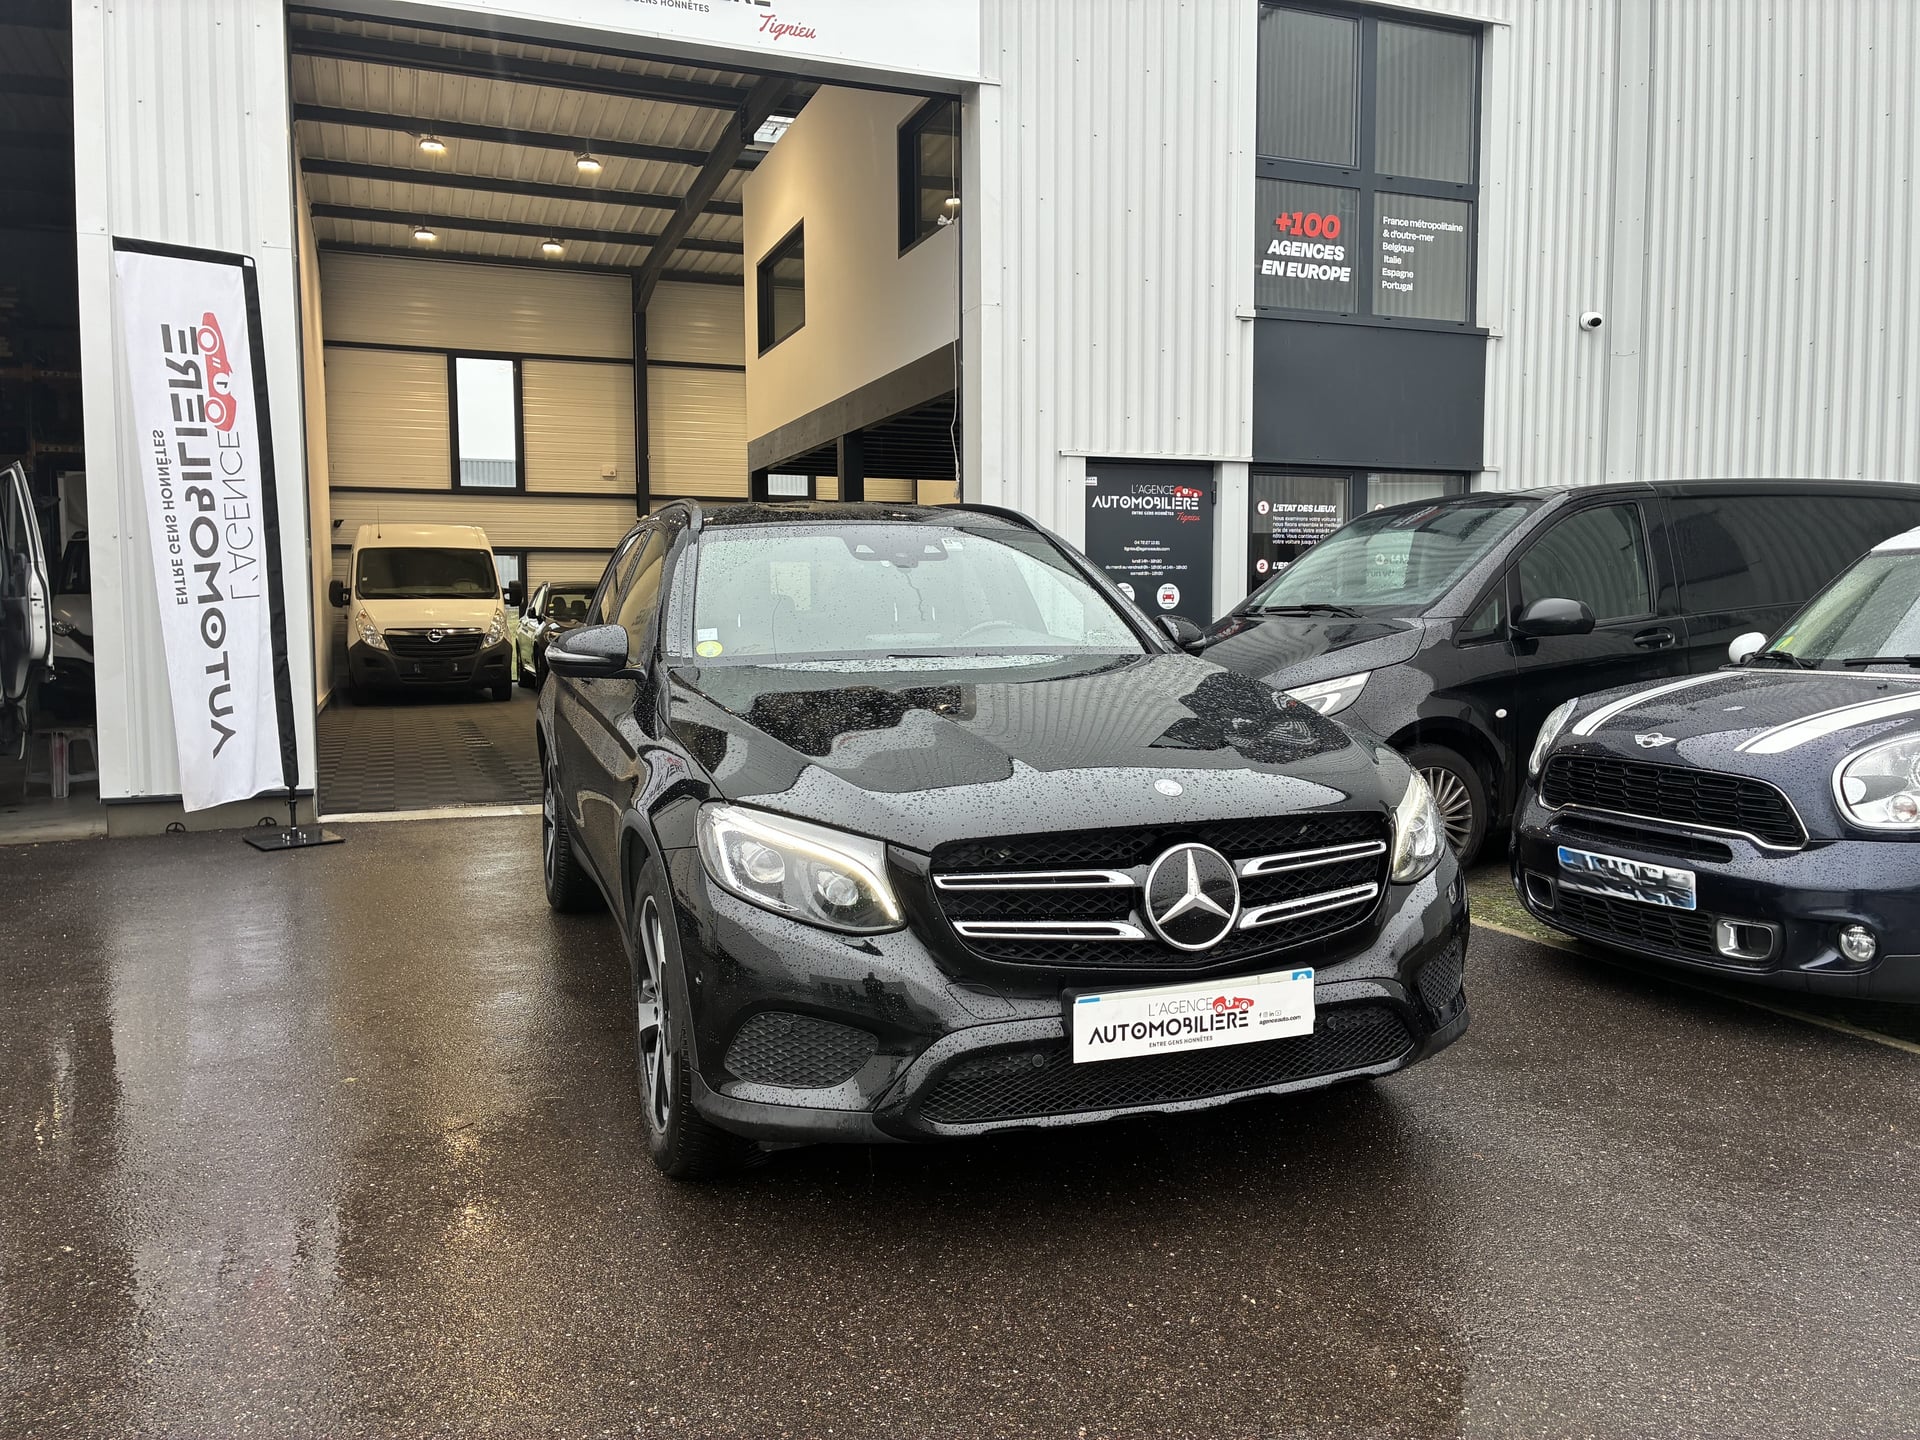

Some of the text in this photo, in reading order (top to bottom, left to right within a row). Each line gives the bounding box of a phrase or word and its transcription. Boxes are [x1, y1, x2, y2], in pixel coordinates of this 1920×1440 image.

[759, 13, 817, 41] Tignieu
[1275, 212, 1341, 239] +100
[1382, 215, 1464, 233] France métropolitaine
[1382, 229, 1435, 242] & d'outre-mer
[1267, 239, 1345, 261] AGENCES
[1382, 241, 1415, 254] Belgique
[1383, 254, 1402, 265] Italie
[1261, 259, 1352, 282] EN EUROPE
[1382, 267, 1414, 279] Espagne
[1382, 280, 1413, 292] Portugal
[1131, 484, 1175, 495] L'AGENCE
[1272, 503, 1336, 513] L'ETAT DES LIEUX
[1148, 997, 1213, 1017] L'AGENCE
[1168, 1038, 1183, 1046] GENS
